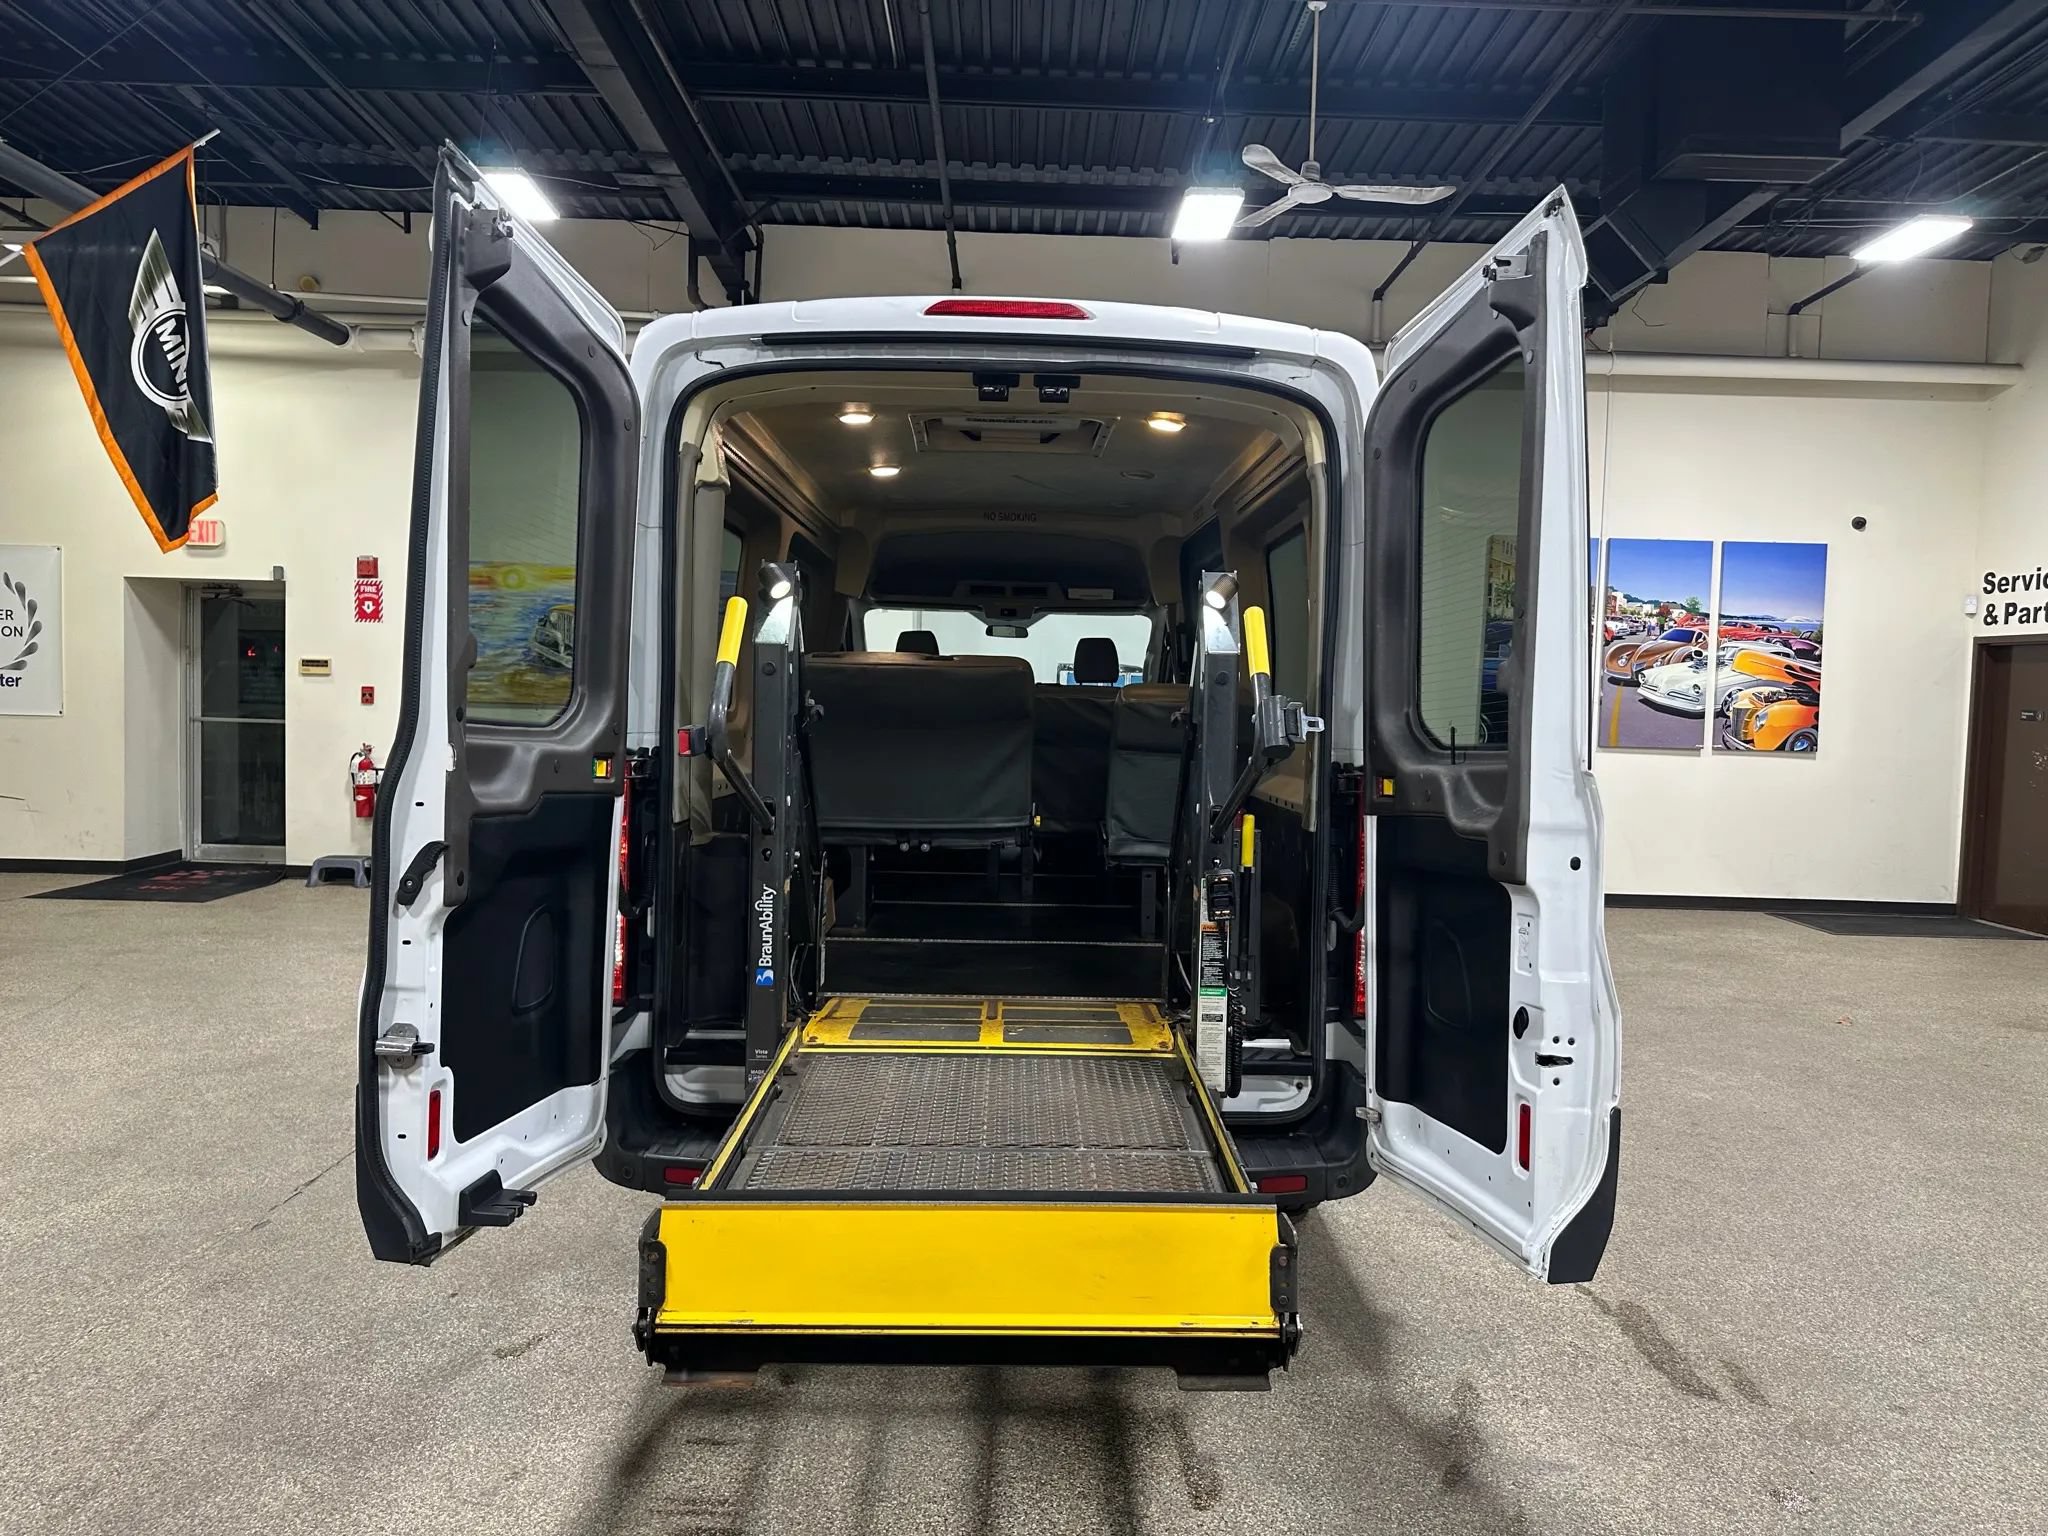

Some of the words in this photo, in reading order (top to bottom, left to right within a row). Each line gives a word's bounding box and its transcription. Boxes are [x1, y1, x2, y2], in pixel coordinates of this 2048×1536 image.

[983, 512, 997, 521] NO
[999, 512, 1037, 522] SMOKING
[189, 520, 218, 543] EXIT
[360, 585, 377, 593] FIRE
[1983, 603, 1999, 626] &
[754, 883, 777, 967] BraunAbility
